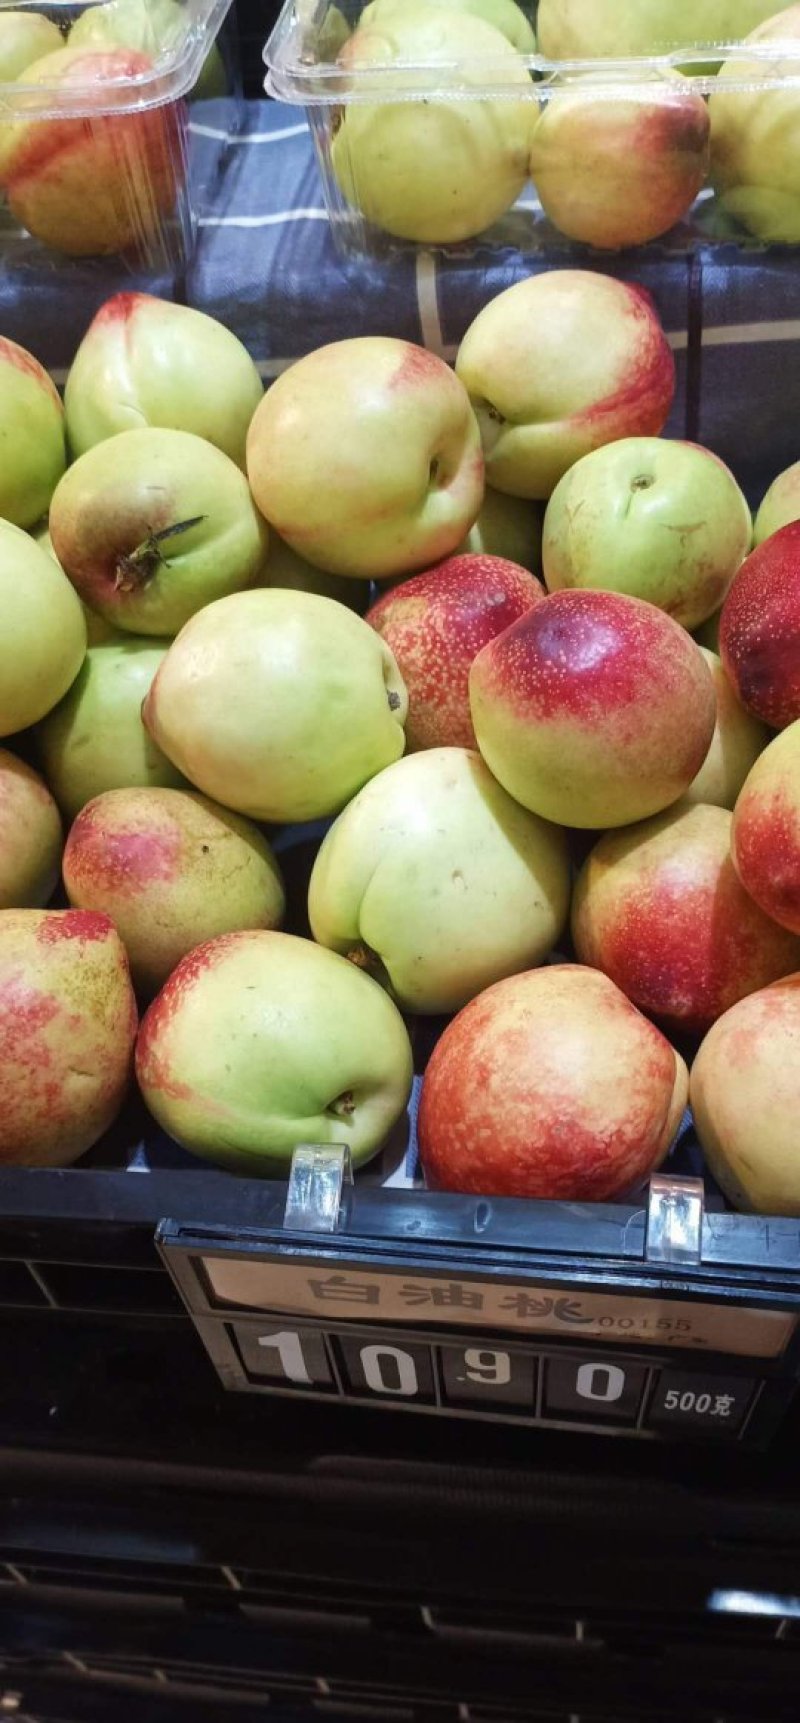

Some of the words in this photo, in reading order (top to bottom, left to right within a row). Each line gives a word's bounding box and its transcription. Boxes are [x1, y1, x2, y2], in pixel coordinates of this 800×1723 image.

[307, 1275, 594, 1323] 白油桃
[598, 1316, 692, 1332] 00155
[664, 1390, 735, 1416] 500克
